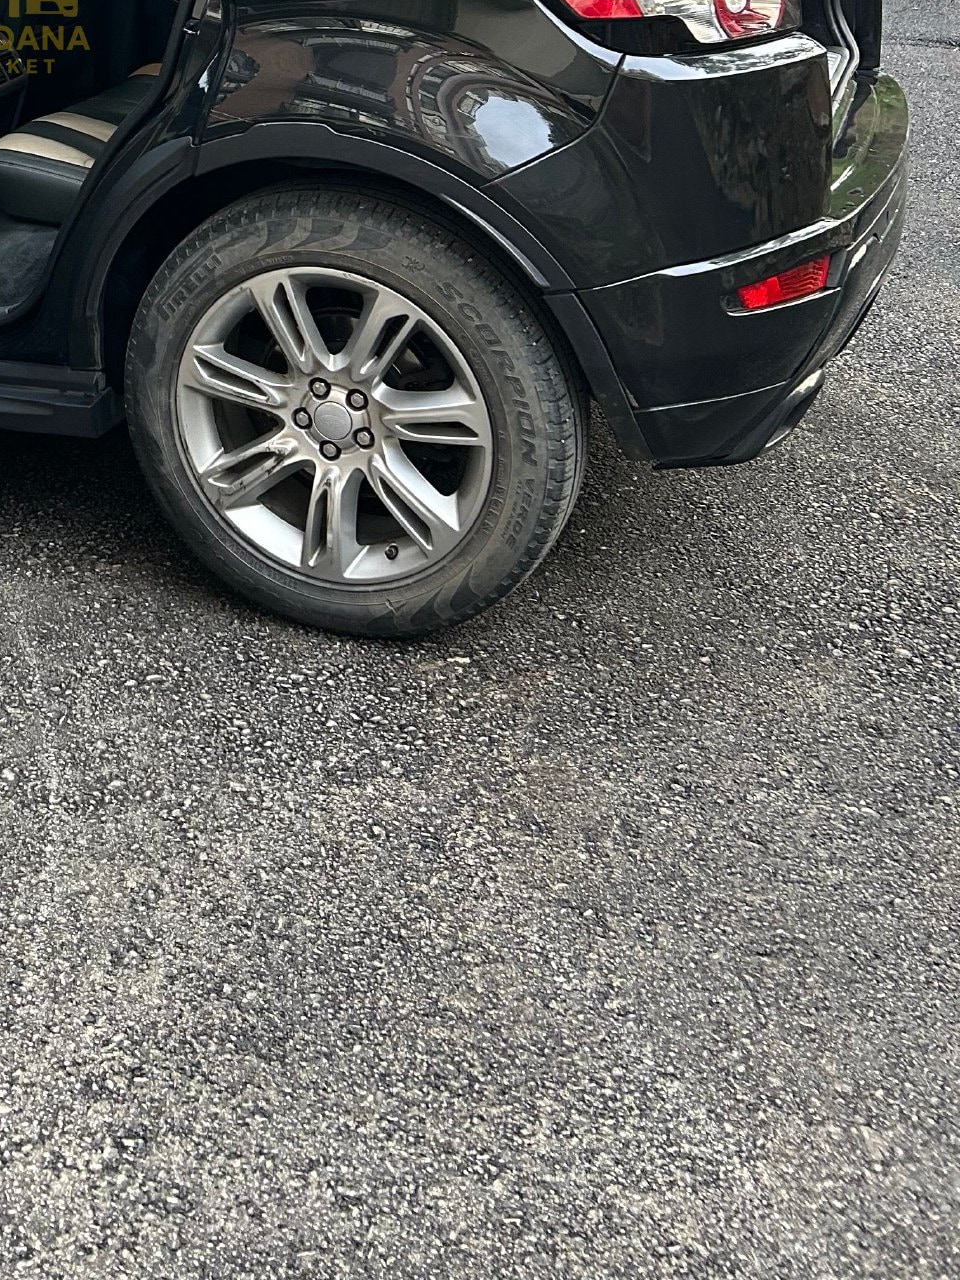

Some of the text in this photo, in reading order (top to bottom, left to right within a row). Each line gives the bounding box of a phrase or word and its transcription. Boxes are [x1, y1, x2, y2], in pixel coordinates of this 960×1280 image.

[152, 246, 222, 321] PIRELLI
[434, 281, 538, 550] SCORPION VERDE
